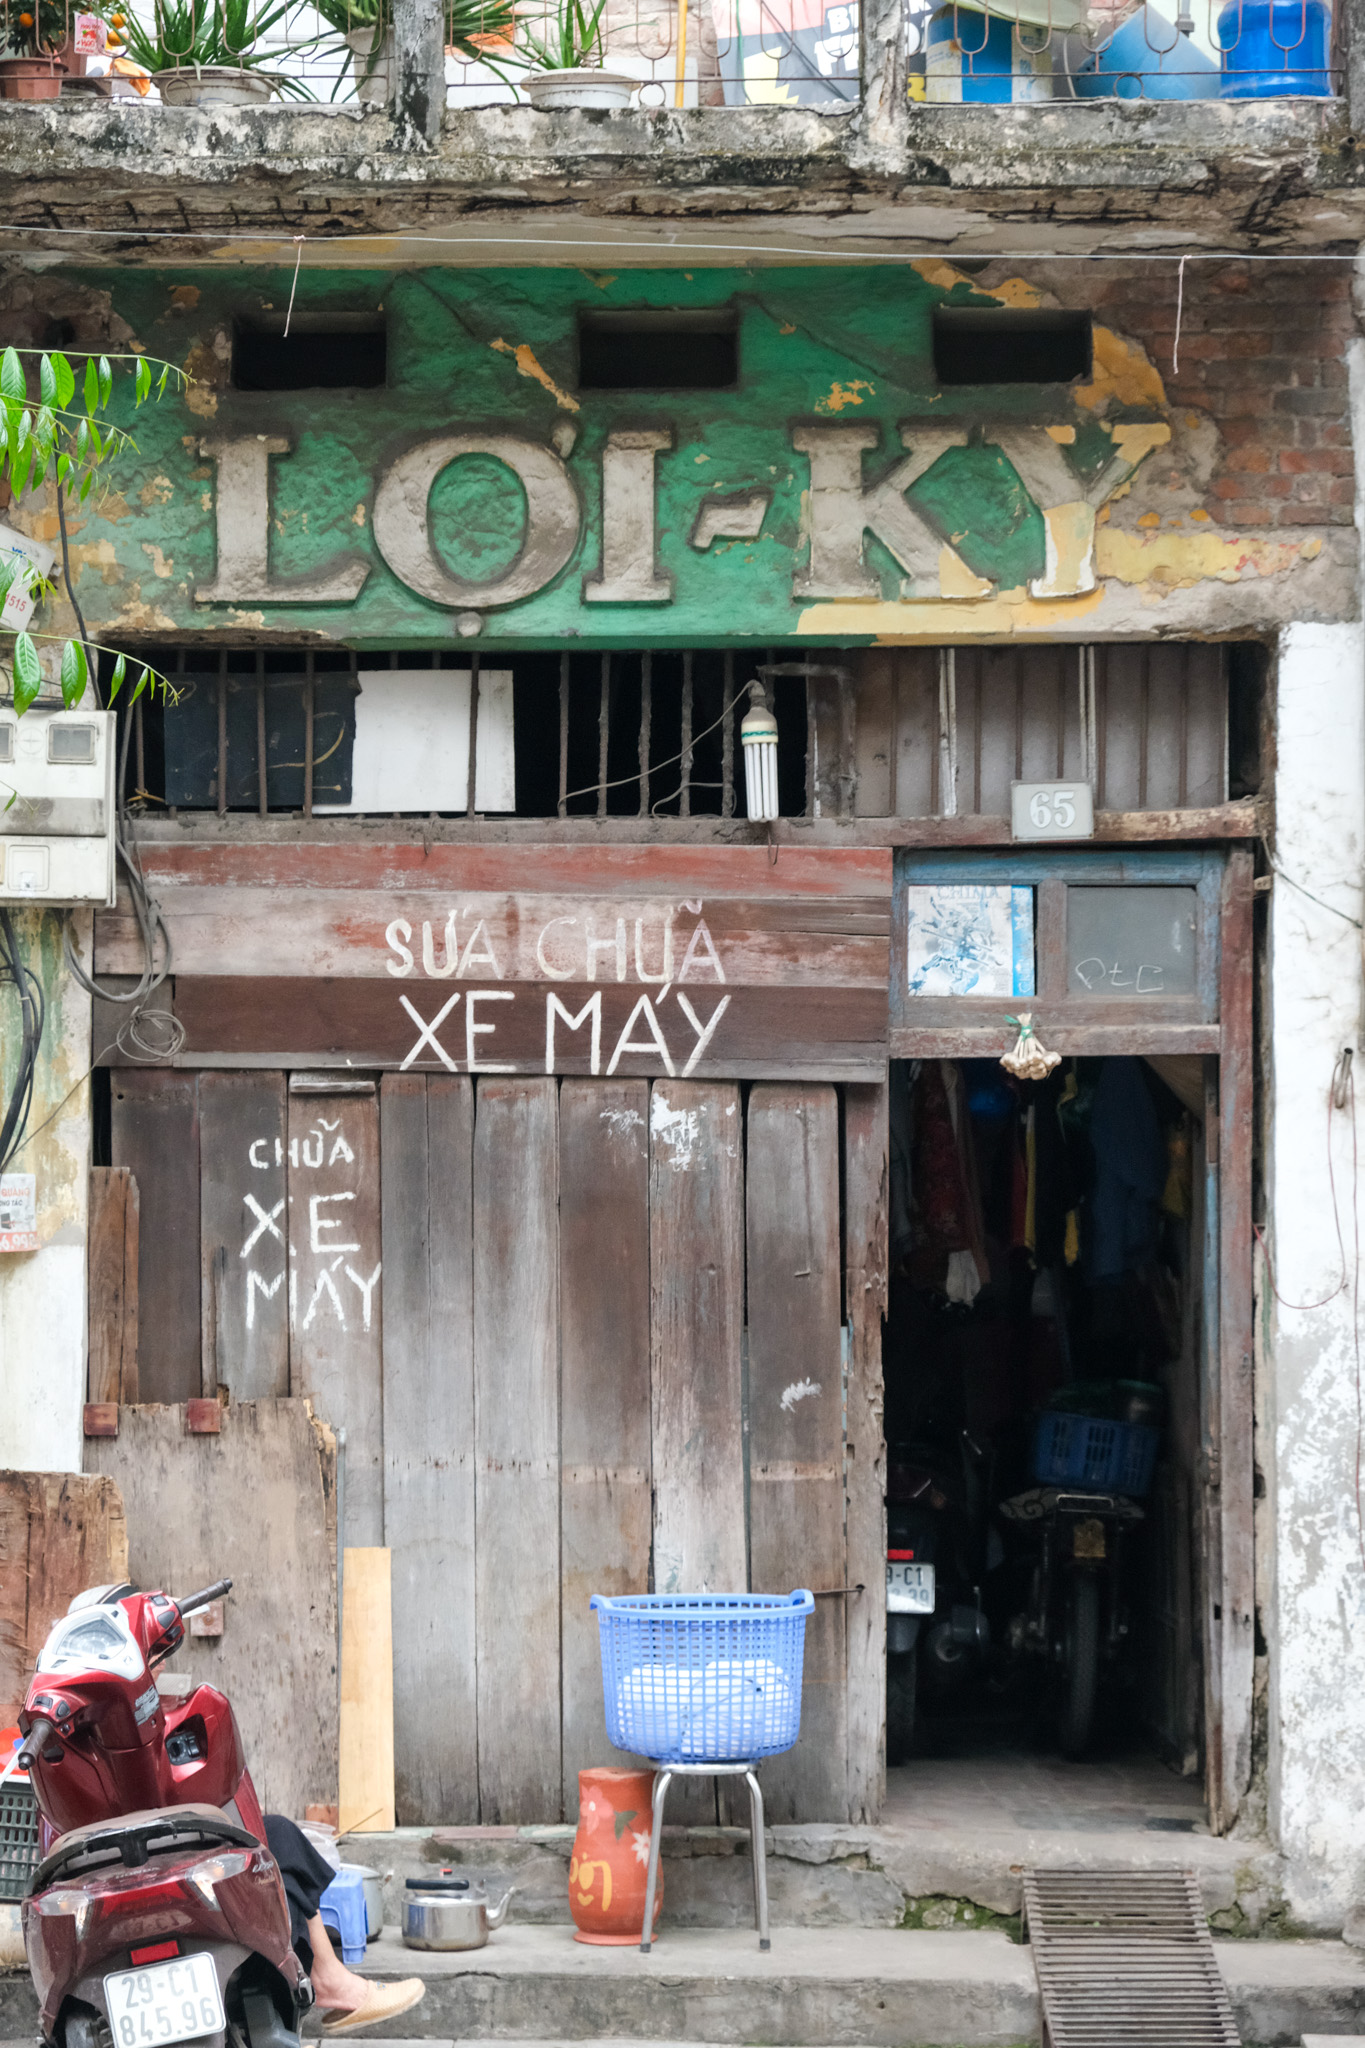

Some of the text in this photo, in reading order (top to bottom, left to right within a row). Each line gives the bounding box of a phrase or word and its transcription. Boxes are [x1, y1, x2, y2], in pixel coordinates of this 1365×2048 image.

[1029, 790, 1077, 829] 65
[399, 983, 732, 1078] XE MÁY
[239, 1192, 361, 1257] XE
[121, 1962, 199, 2009] 29-C1
[119, 1996, 217, 2047] 845.96
